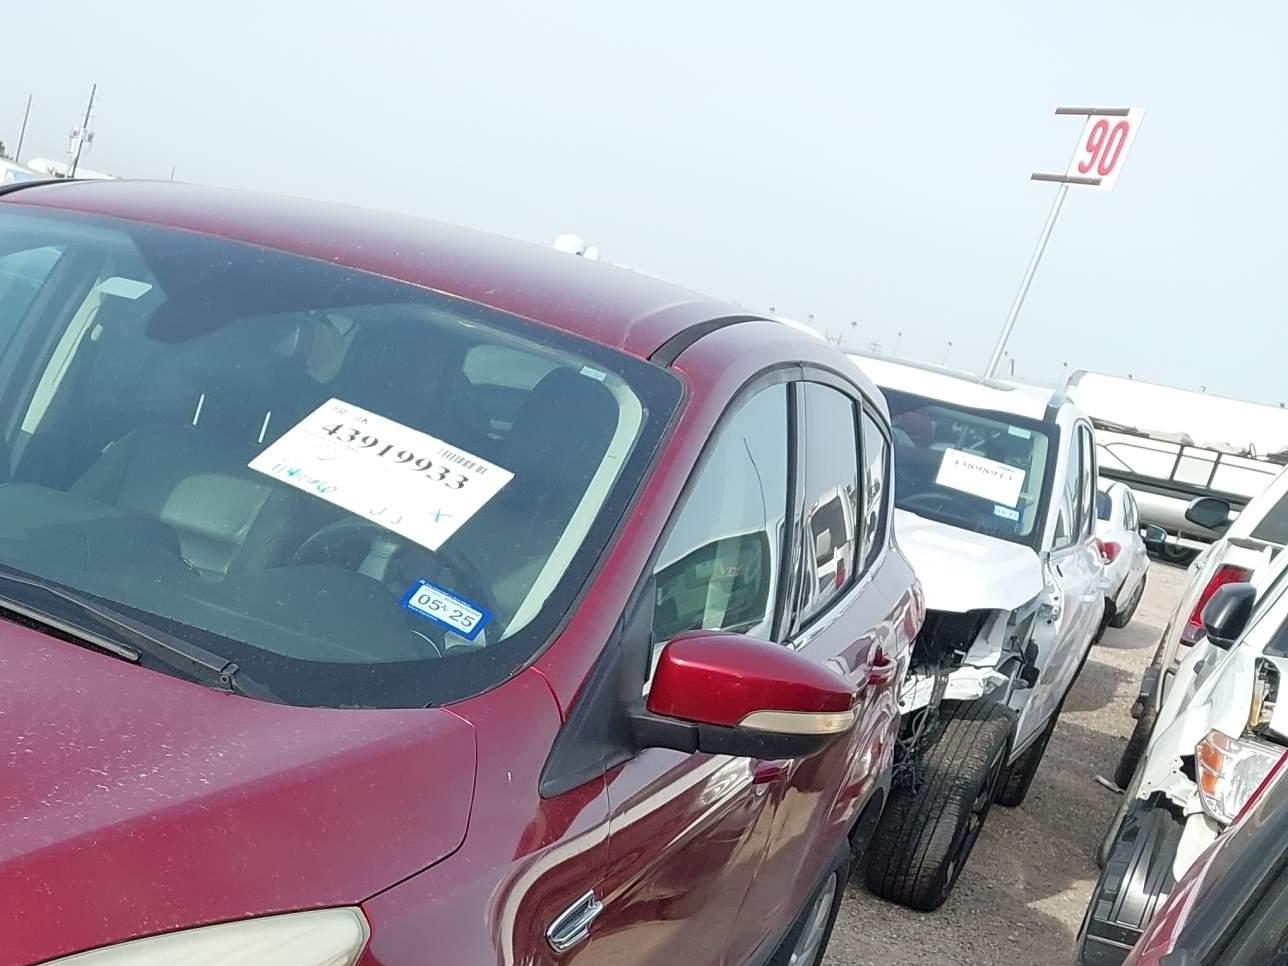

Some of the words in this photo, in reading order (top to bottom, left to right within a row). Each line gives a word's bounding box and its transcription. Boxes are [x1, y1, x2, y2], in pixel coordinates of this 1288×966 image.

[1078, 118, 1130, 176] 90
[321, 423, 470, 490] 43919933
[417, 594, 443, 611] 05
[449, 609, 475, 627] 25
